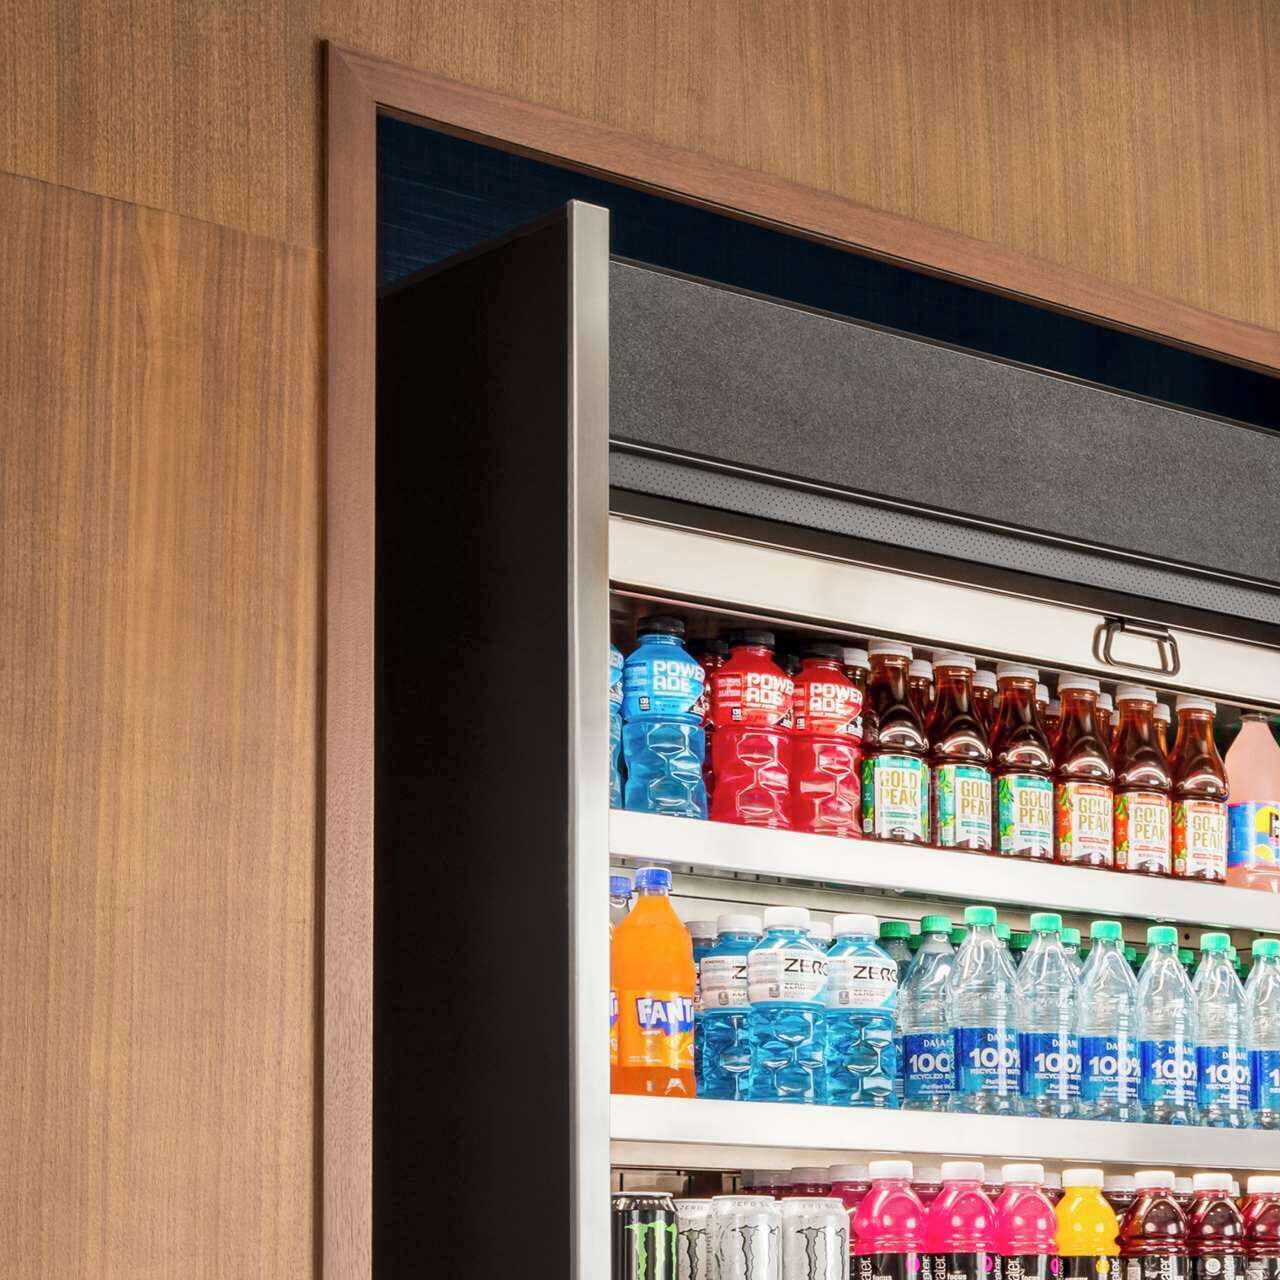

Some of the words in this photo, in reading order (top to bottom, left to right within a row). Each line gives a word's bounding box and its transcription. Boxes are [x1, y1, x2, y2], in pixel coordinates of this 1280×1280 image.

[881, 769, 918, 789] GOLD
[881, 788, 918, 807] PEAK
[637, 997, 694, 1025] FANT
[947, 1273, 967, 1280] focus
